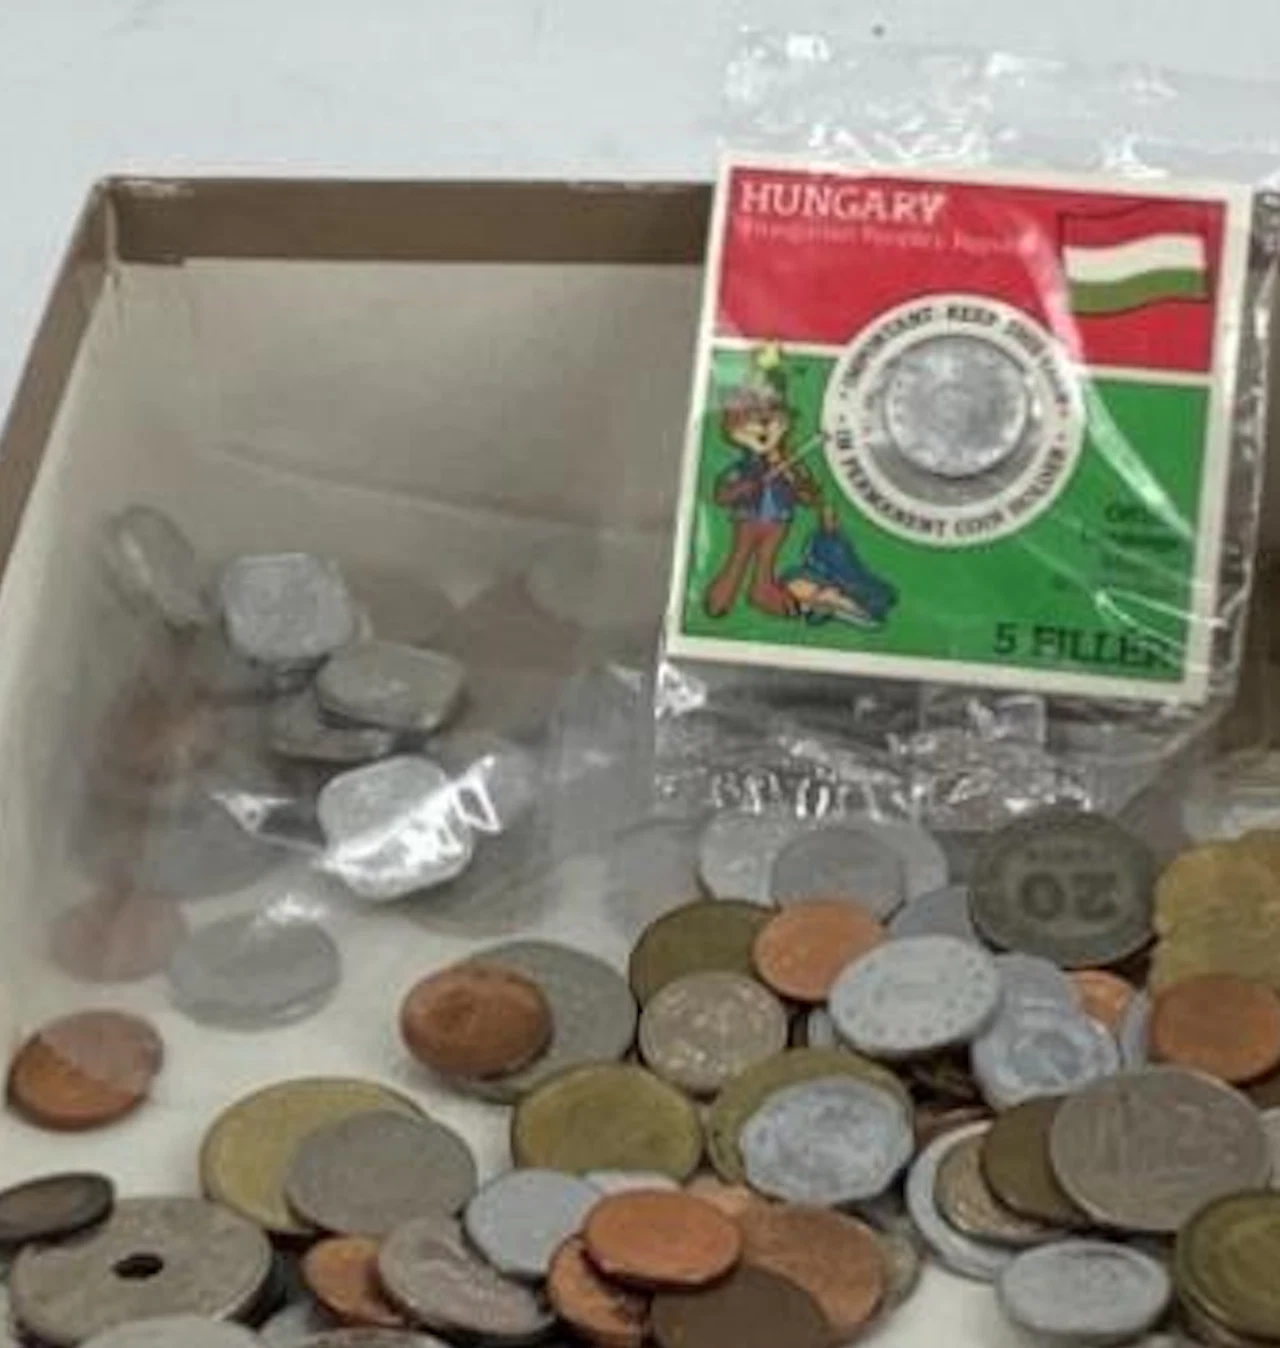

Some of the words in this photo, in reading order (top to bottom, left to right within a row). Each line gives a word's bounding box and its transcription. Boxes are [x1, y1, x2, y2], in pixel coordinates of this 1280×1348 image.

[739, 178, 949, 226] HUNGARY
[993, 622, 1018, 654] 5
[1019, 871, 1118, 922] 20
